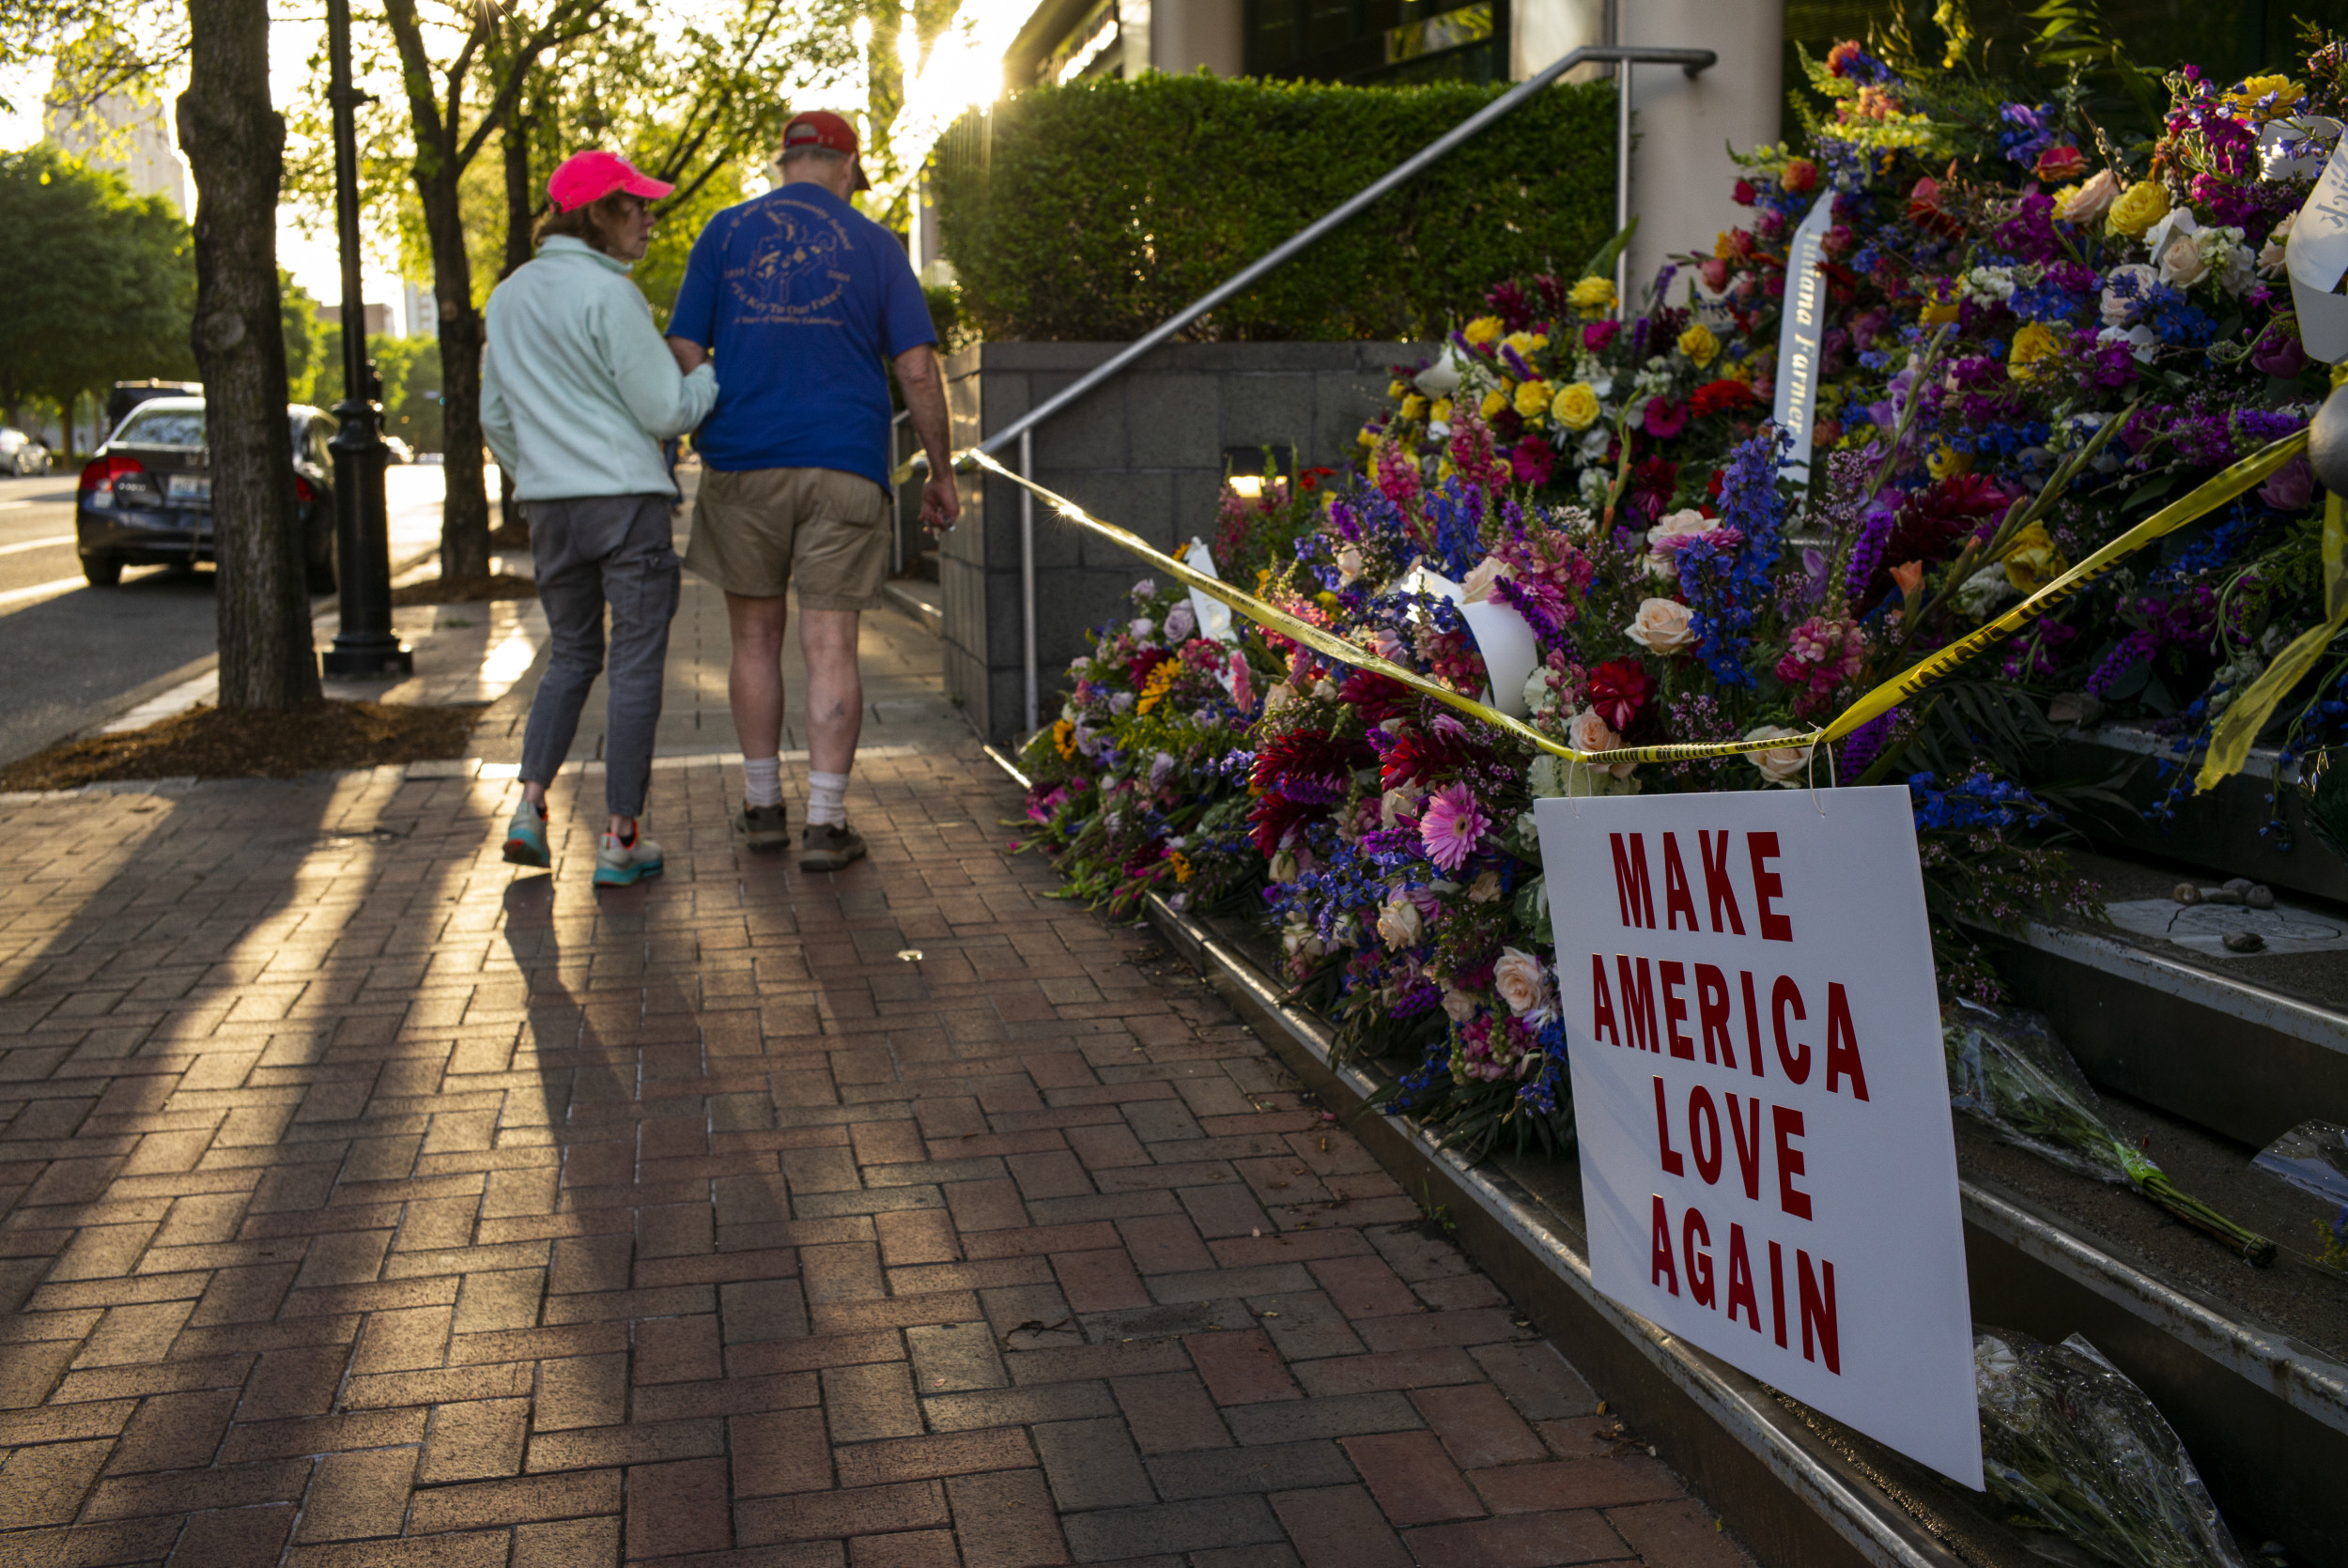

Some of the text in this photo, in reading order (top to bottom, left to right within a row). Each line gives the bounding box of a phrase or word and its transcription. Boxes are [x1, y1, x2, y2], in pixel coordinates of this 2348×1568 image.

[768, 302, 785, 315] To
[786, 303, 811, 315] Our
[1788, 229, 1824, 435] Juliana Farmer
[1609, 830, 1793, 942] MAKE
[1592, 953, 1870, 1102] AMERICA
[1653, 1075, 1813, 1222] LOVE
[1652, 1193, 1841, 1376] AGAIN
